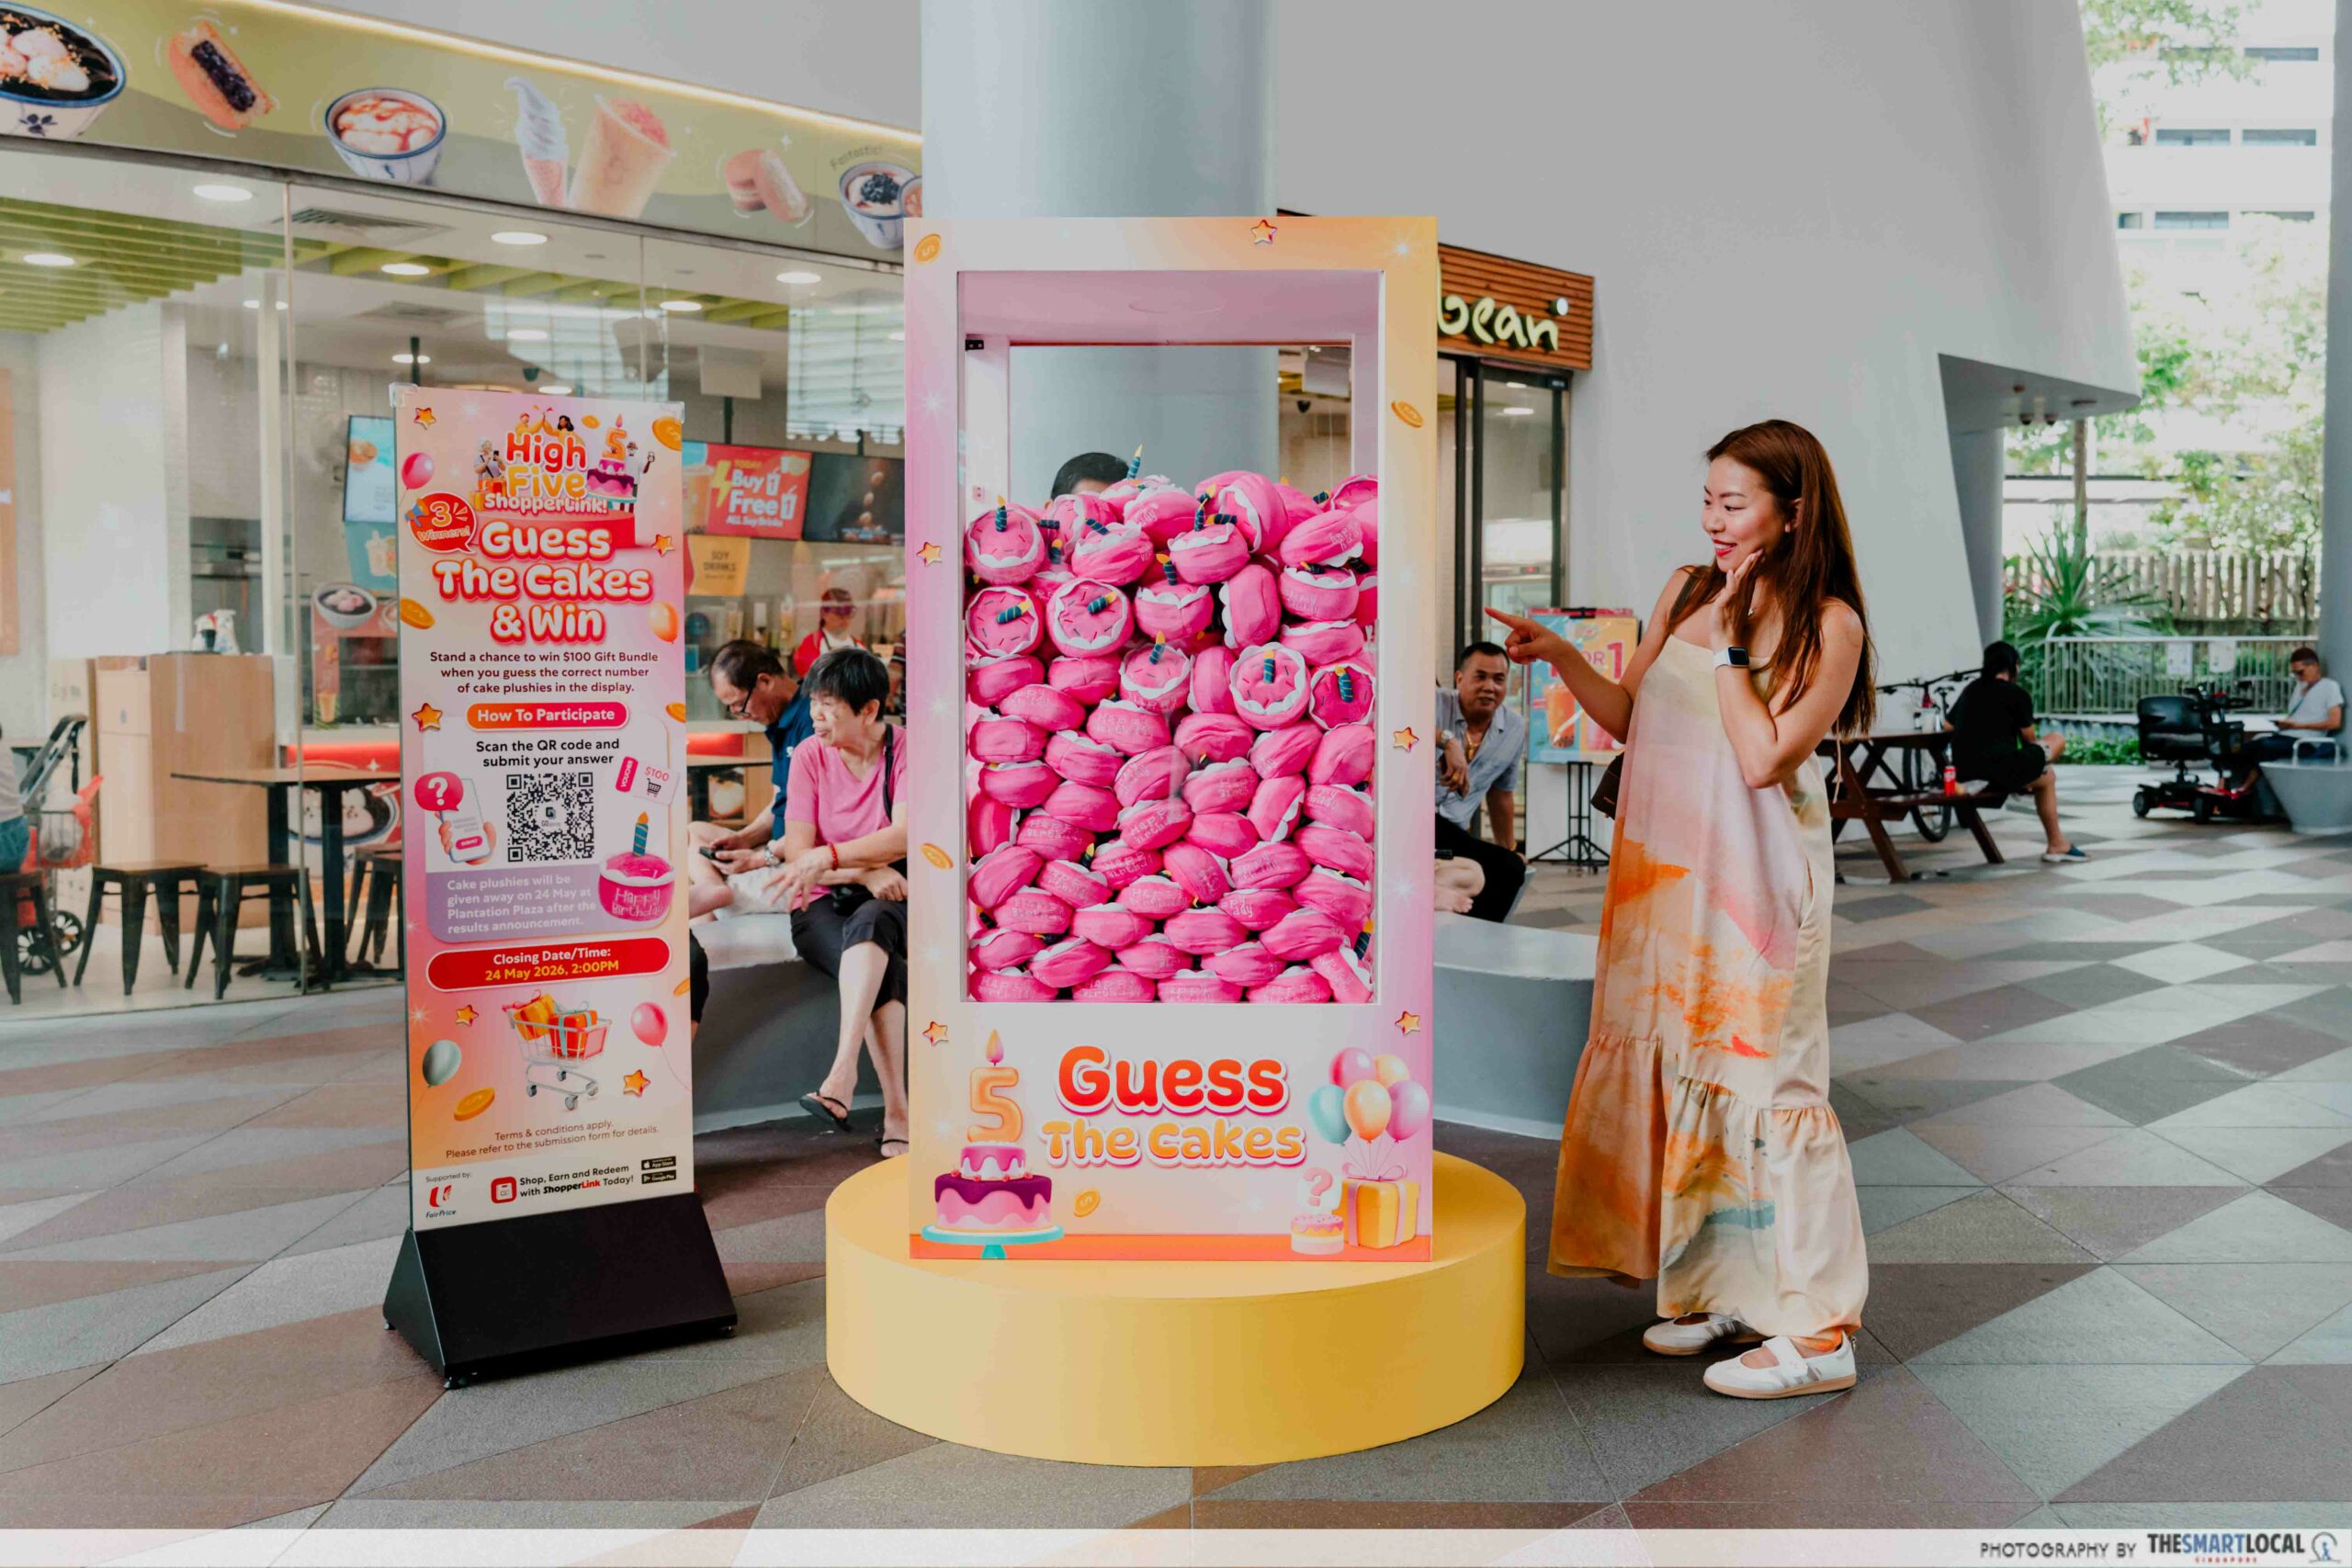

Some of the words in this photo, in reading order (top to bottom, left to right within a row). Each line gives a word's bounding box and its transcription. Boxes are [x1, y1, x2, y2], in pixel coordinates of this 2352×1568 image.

[506, 432, 586, 473] High
[507, 465, 586, 498] Five
[732, 469, 764, 493] Buy
[729, 489, 779, 515] Free
[430, 501, 453, 528] 3
[417, 525, 470, 542] Winners!
[481, 521, 611, 558] Guess
[435, 560, 518, 597] The
[526, 565, 650, 601] Cakes
[492, 605, 524, 641] &
[530, 605, 604, 641] Win
[431, 651, 466, 661] Stand
[469, 653, 476, 661] a
[480, 652, 520, 661] chance
[525, 653, 536, 661] to
[539, 652, 560, 661] win
[563, 651, 591, 662] $100
[594, 651, 616, 661] Gift
[619, 651, 658, 661] Bundle
[441, 668, 474, 677] when
[478, 671, 500, 680] you
[503, 671, 536, 680] guess
[539, 668, 559, 677] the
[561, 669, 602, 677] correct
[605, 668, 649, 677] number
[458, 683, 470, 694] of
[473, 683, 500, 694] cake
[503, 682, 552, 695] plushies
[555, 682, 566, 693] in
[570, 682, 588, 693] the
[591, 682, 634, 694] display.
[477, 710, 513, 722] How
[515, 708, 533, 722] To
[537, 708, 616, 724] Participate
[476, 741, 508, 752] Scan
[512, 740, 534, 751] the
[537, 739, 557, 750] QR
[560, 739, 593, 750] code
[595, 739, 619, 750] and
[483, 755, 530, 767] submit
[534, 758, 564, 768] your
[567, 755, 614, 765] answer
[644, 765, 670, 782] $100
[447, 879, 477, 890] Cake
[480, 876, 529, 891] plushies
[532, 874, 552, 885] will
[556, 874, 571, 885] be
[447, 894, 480, 908] given
[483, 893, 514, 904] away
[517, 892, 532, 900] on
[535, 889, 550, 899] 24
[553, 888, 577, 899] May
[580, 888, 592, 897] at
[615, 886, 662, 907] Happy
[447, 907, 510, 919] Plantation
[514, 904, 544, 915] Plaza
[547, 902, 574, 912] after
[578, 901, 596, 911] the
[447, 921, 489, 934] results
[492, 917, 584, 931] announcement.
[493, 952, 539, 964] Closing
[542, 948, 611, 962] Date/Time:
[485, 969, 502, 981] 24
[504, 968, 531, 981] May
[534, 964, 569, 977] 2026,
[571, 960, 619, 974] 2:00PM
[1058, 1045, 1286, 1108] Guess
[495, 1130, 523, 1141] Terms
[526, 1129, 532, 1138] &
[535, 1122, 584, 1136] conditions
[586, 1120, 614, 1131] apply.
[1042, 1118, 1140, 1159] The
[1149, 1118, 1303, 1159] Cakes
[446, 1148, 477, 1158] Please
[479, 1145, 502, 1156] refer
[504, 1143, 514, 1152] to
[516, 1138, 532, 1150] the
[535, 1134, 586, 1147] submission
[588, 1131, 610, 1142] form
[612, 1129, 625, 1138] for
[628, 1125, 659, 1136] details.
[425, 1172, 460, 1183] Supported
[548, 1172, 570, 1182] Earn
[571, 1168, 591, 1179] and
[593, 1165, 630, 1176] Redeem
[520, 1187, 541, 1198] with
[543, 1179, 601, 1194] ShopperLink
[603, 1175, 634, 1187] Today!
[426, 1209, 457, 1219] FairPrice
